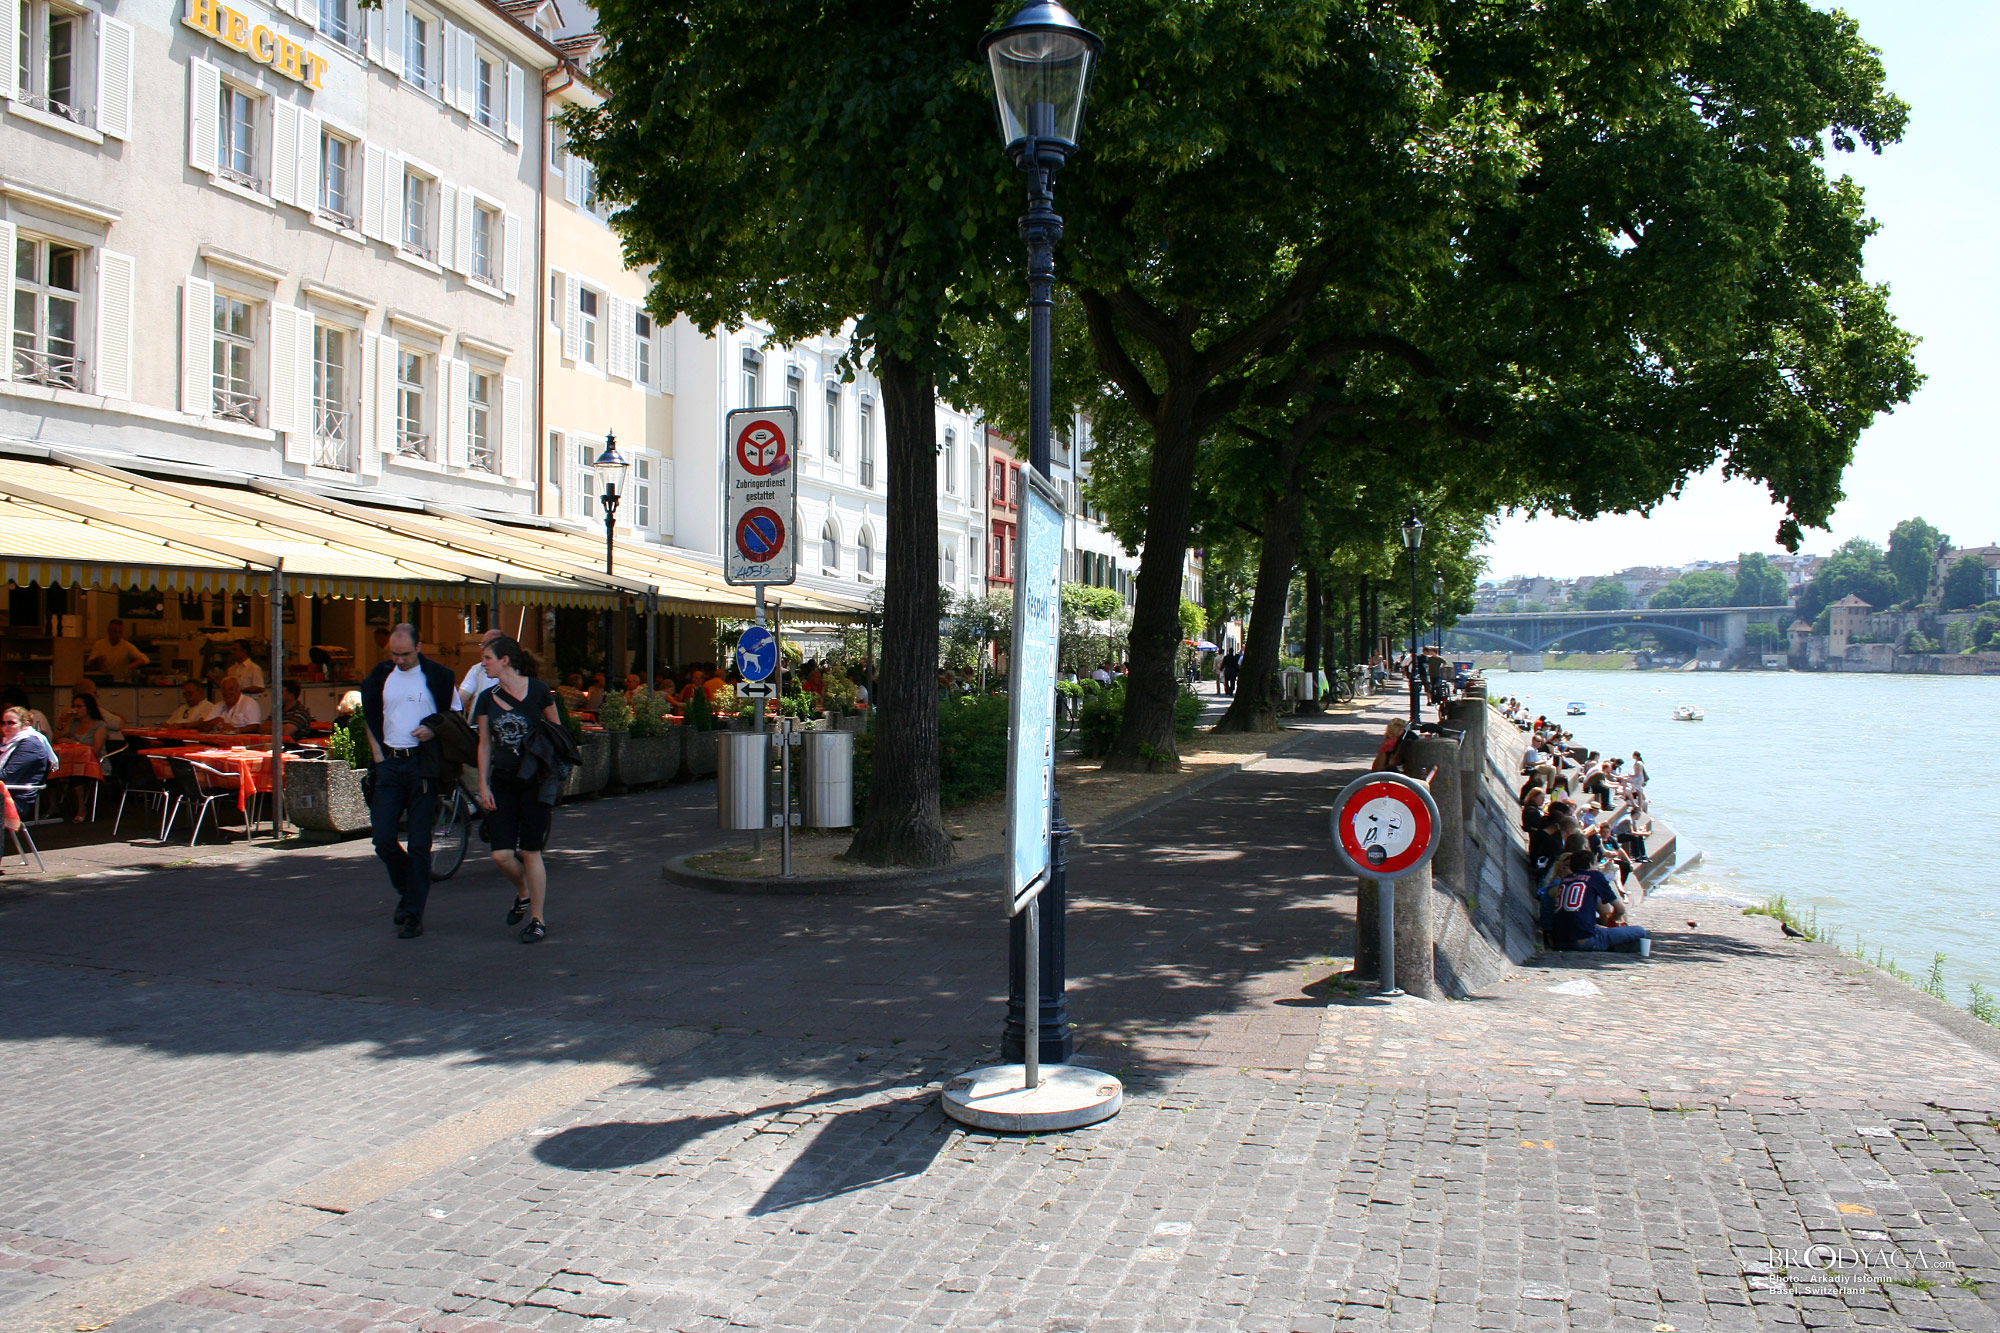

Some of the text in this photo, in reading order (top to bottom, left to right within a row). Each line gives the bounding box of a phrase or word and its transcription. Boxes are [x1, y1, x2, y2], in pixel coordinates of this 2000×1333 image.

[183, 0, 328, 91] HECHT
[736, 478, 786, 489] Zubringerdienst
[746, 491, 775, 502] gestattet
